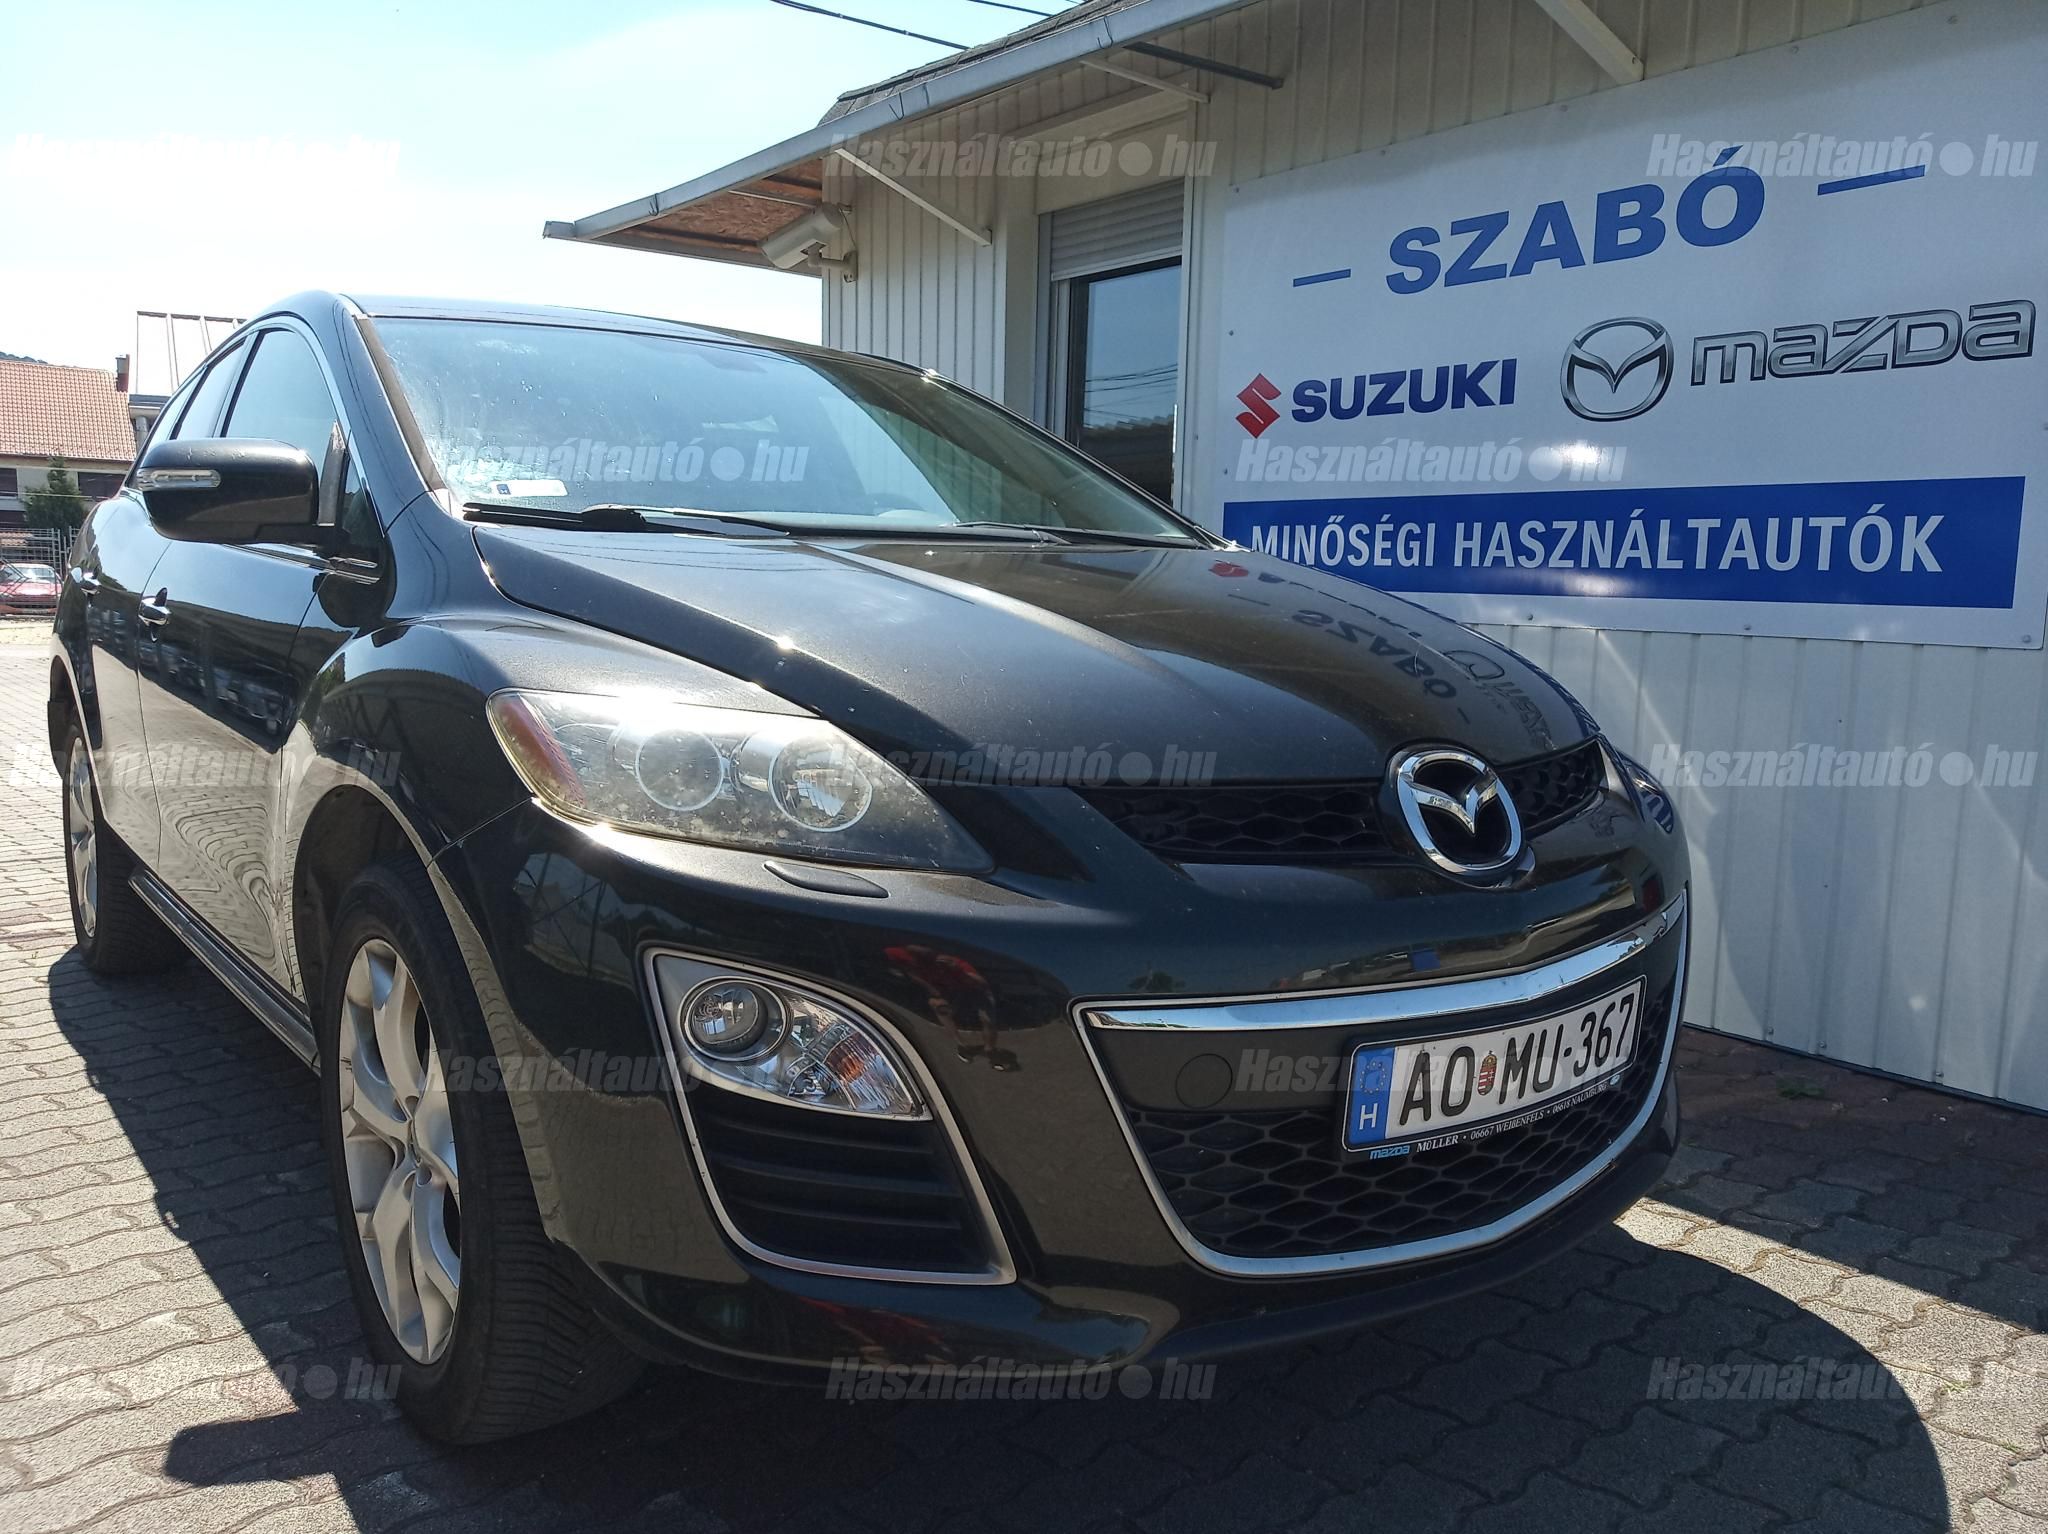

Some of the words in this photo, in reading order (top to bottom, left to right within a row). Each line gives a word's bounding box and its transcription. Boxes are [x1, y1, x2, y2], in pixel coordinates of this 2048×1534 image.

[1385, 145, 1765, 295] SZABÓ
[1291, 358, 1517, 423] SUZUKI
[1251, 514, 1436, 568] MINŐSÉGI
[1454, 503, 1947, 573] HASZNÁLTAUTÓK
[1400, 1045, 1476, 1126] AO
[1499, 992, 1635, 1105] MU-367
[1359, 1103, 1378, 1130] H
[1470, 1125, 1494, 1140] 06667
